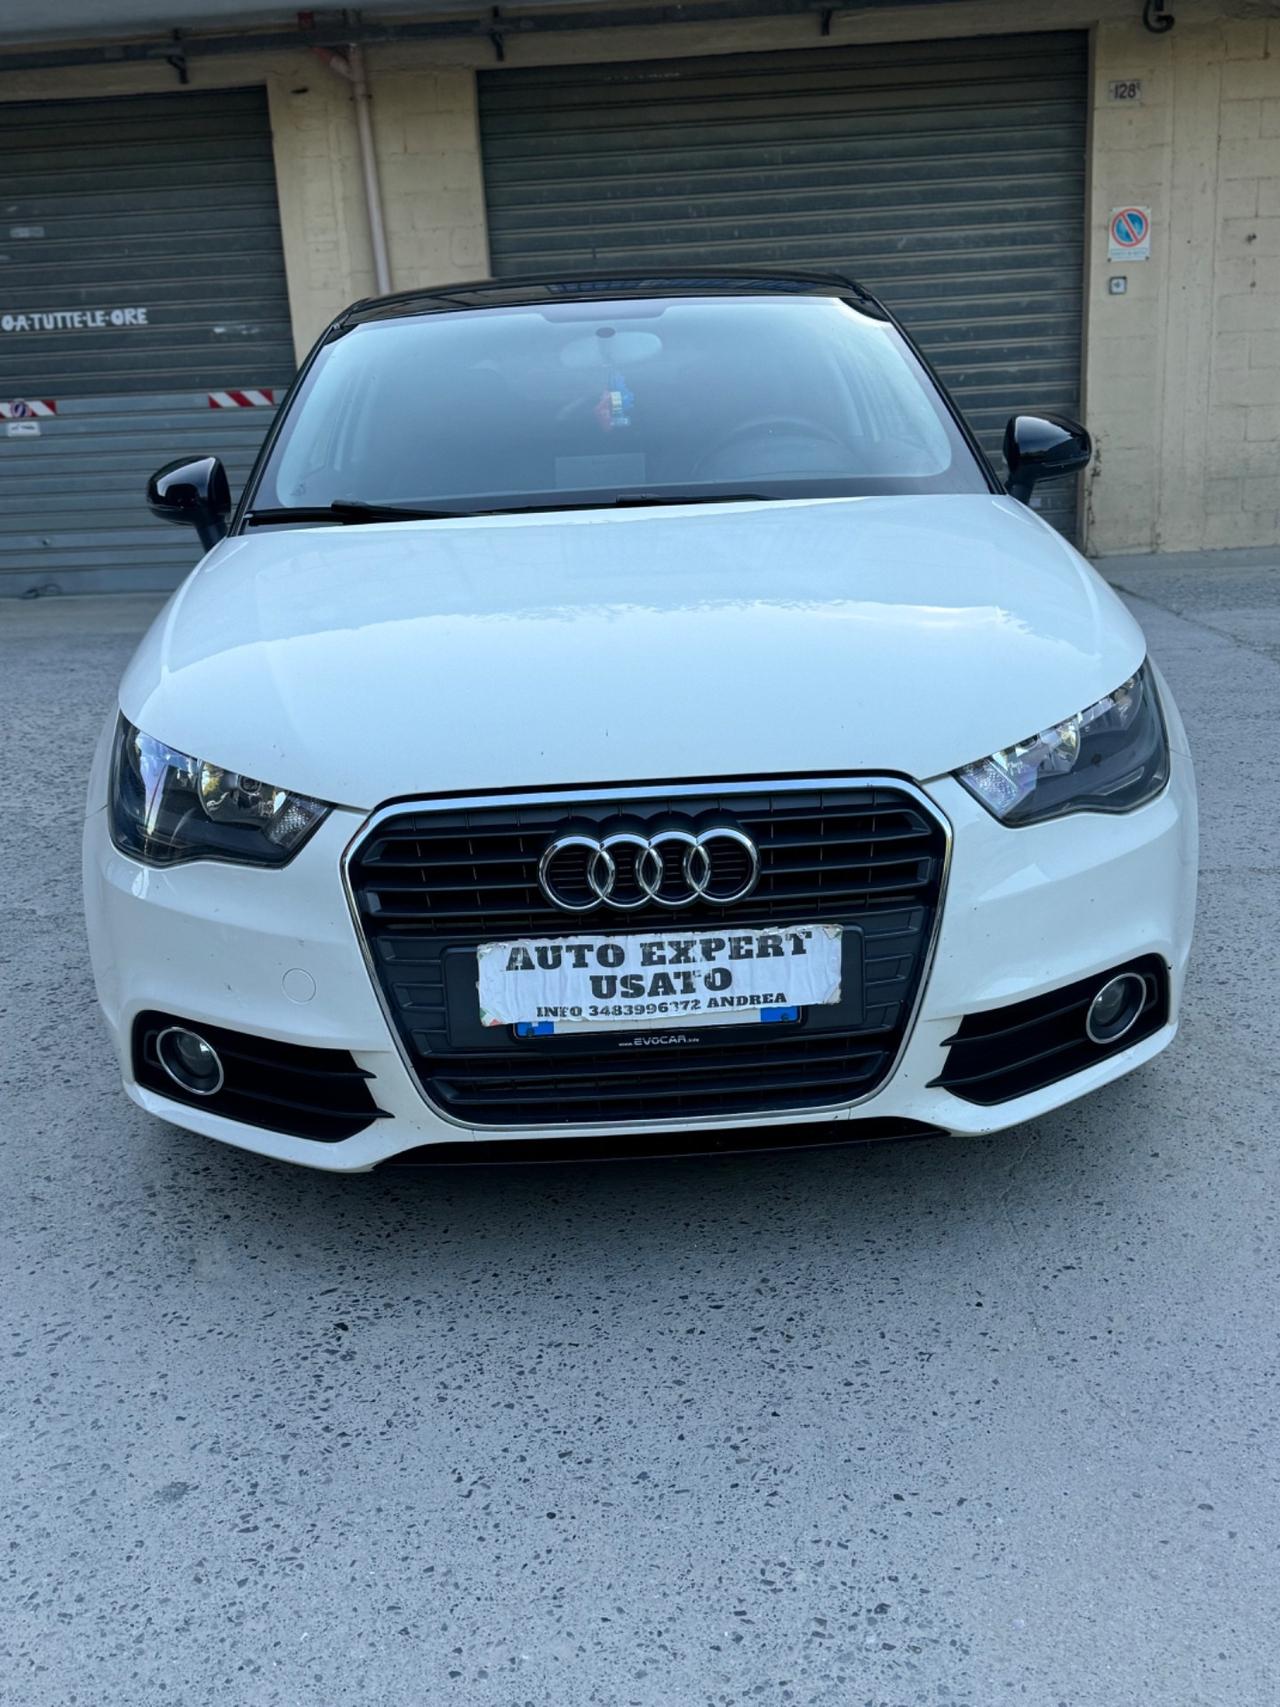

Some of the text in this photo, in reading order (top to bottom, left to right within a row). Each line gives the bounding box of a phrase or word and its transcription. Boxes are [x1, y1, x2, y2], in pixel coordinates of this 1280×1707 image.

[505, 931, 813, 972] AUTO EXPERT
[589, 967, 733, 1000] USATO
[536, 1006, 583, 1018] INFO
[706, 992, 788, 1009] ANDREA
